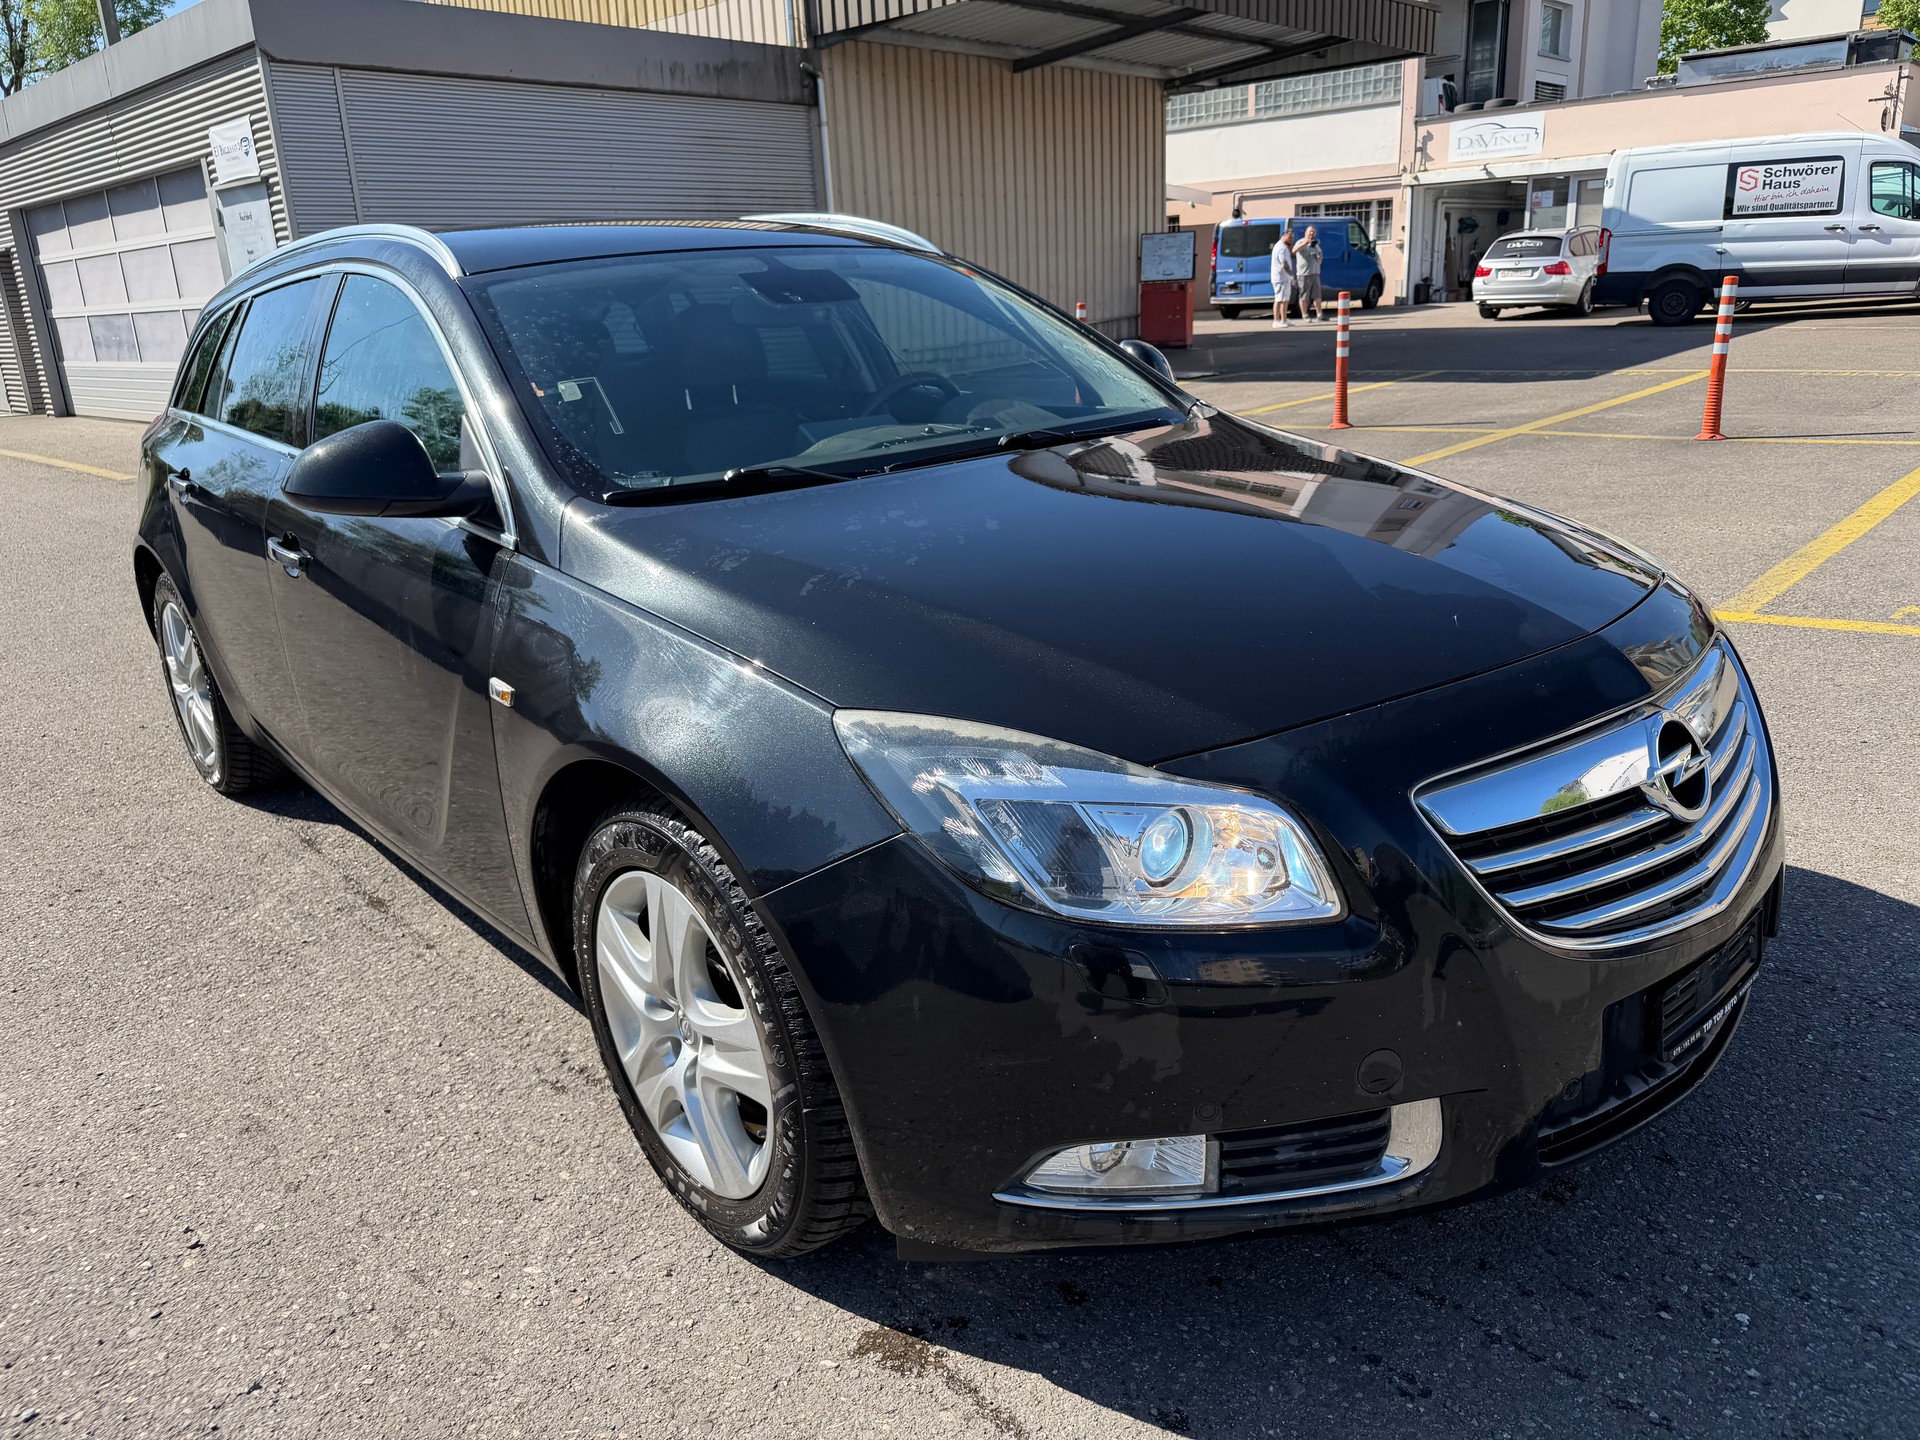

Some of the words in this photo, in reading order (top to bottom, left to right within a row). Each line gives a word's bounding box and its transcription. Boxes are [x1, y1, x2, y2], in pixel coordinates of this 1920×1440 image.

[1763, 164, 1838, 179] Schwörer
[1762, 179, 1801, 190] Haus
[1737, 204, 1750, 213] Wir
[1751, 202, 1768, 212] sind
[1769, 200, 1835, 212] Qualitätspartner.
